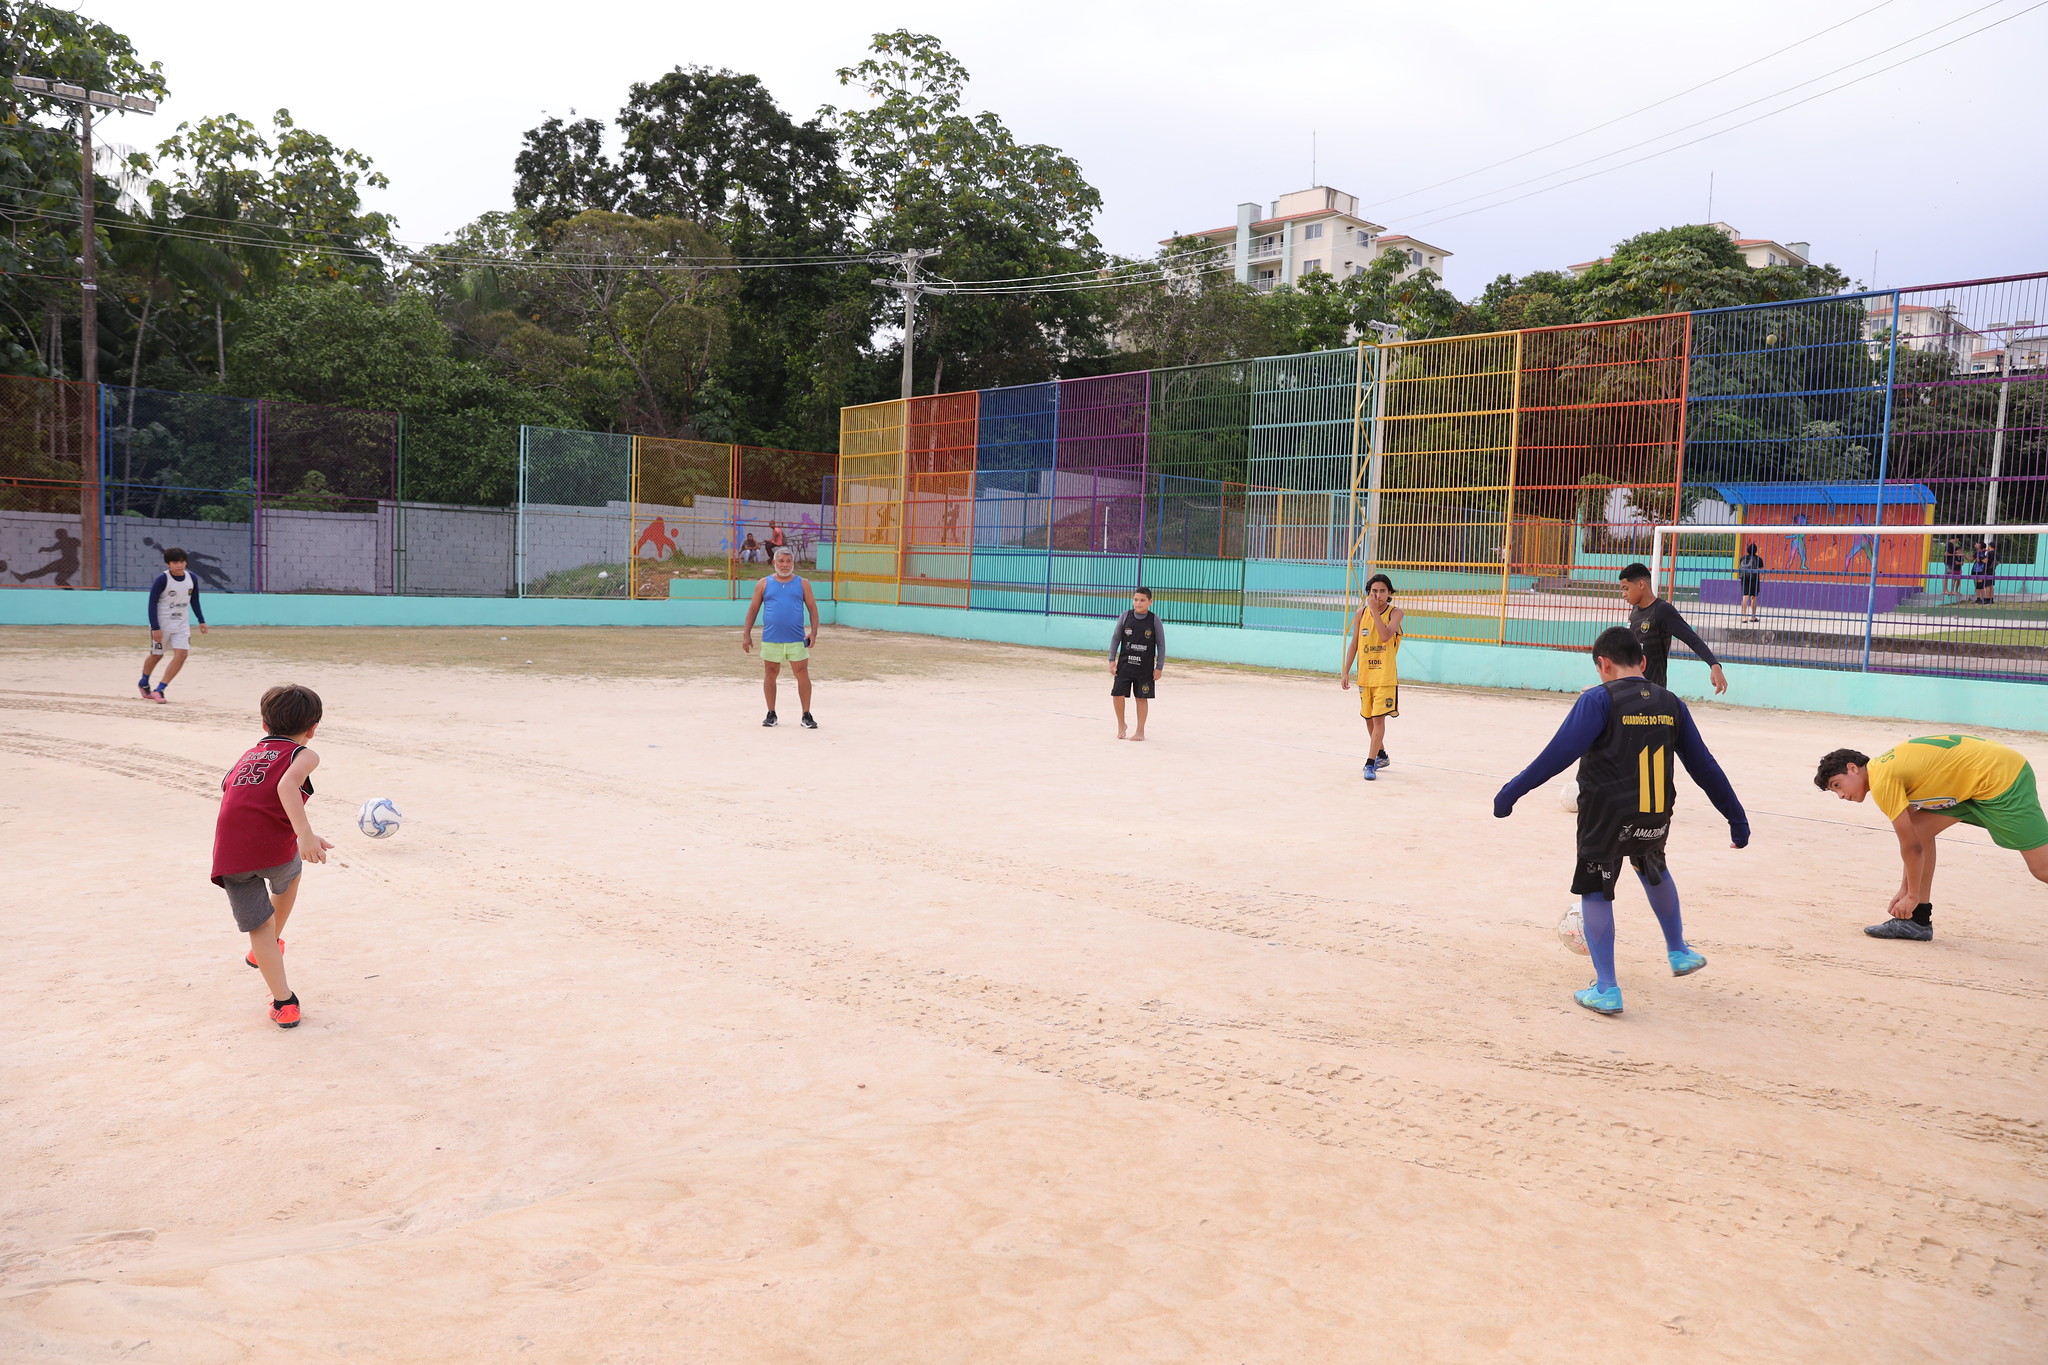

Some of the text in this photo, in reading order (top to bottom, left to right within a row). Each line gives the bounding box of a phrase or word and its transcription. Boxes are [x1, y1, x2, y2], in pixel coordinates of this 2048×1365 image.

[1649, 716, 1657, 725] DO
[231, 762, 271, 787] 25
[1638, 744, 1665, 814] 11
